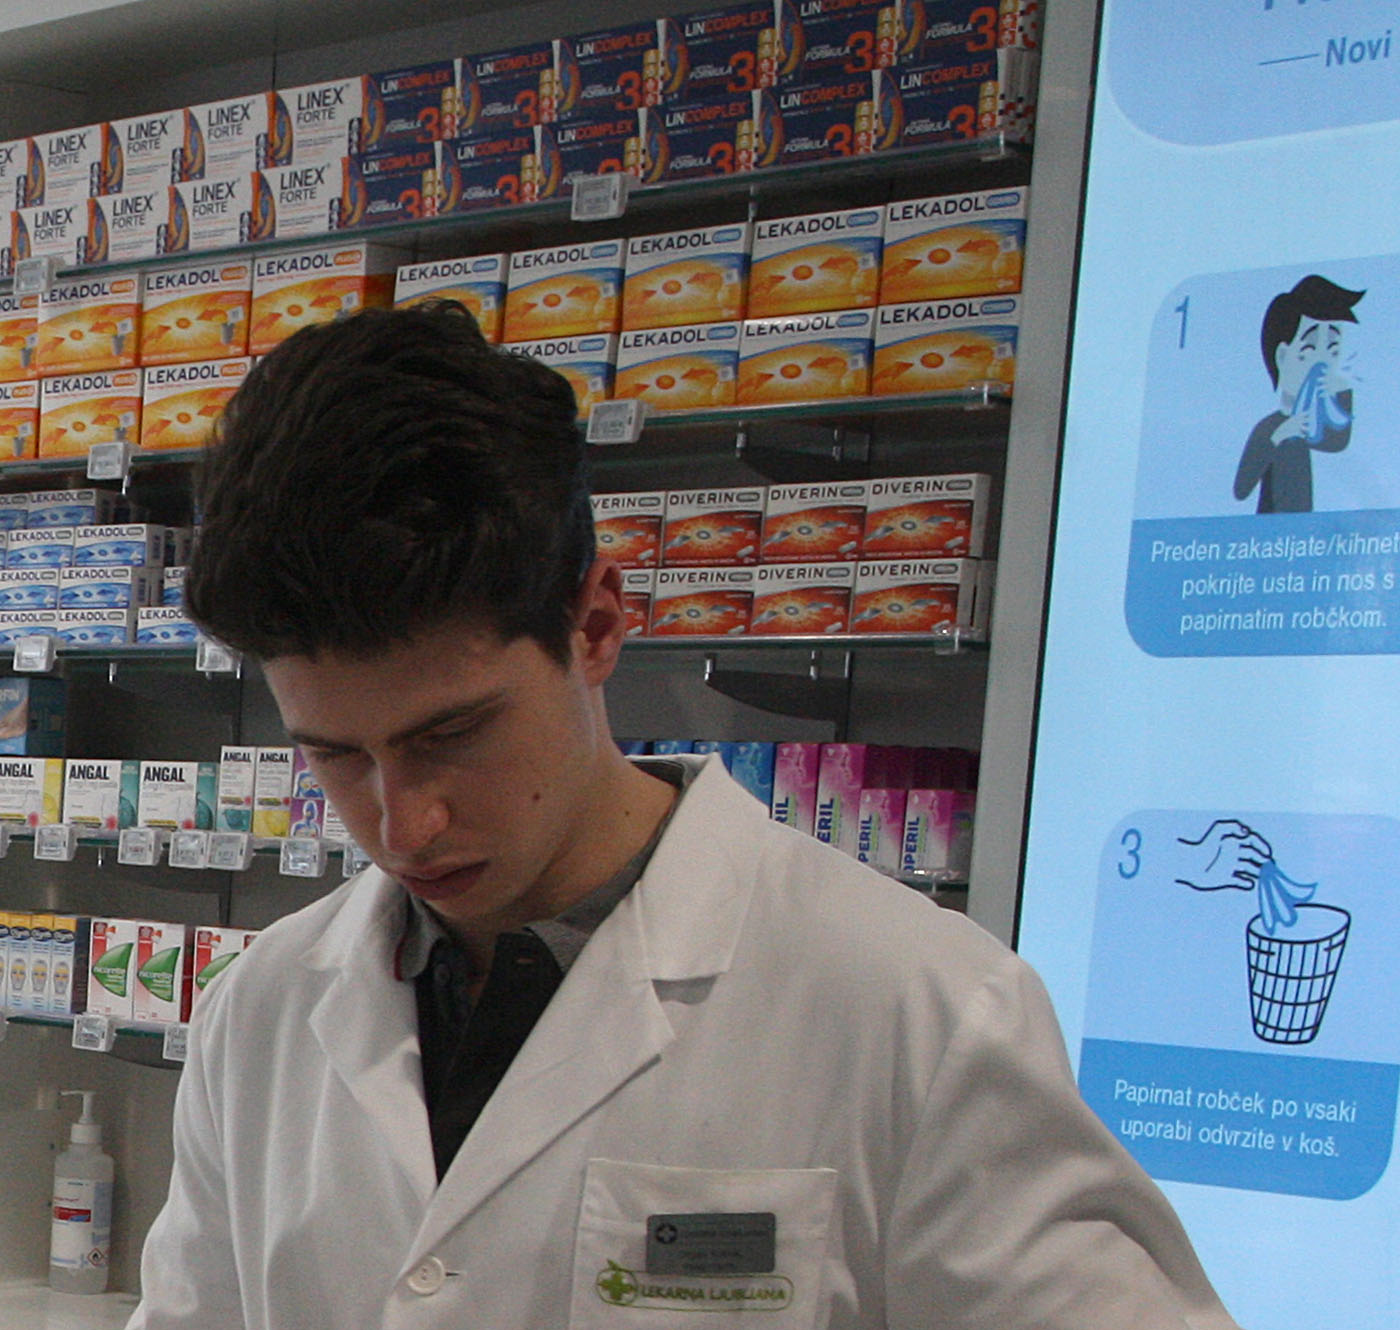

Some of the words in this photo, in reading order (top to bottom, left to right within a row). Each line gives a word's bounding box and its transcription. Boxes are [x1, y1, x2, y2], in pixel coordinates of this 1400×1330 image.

[684, 11, 770, 38] LINCOMPLEX
[967, 6, 998, 52] 3
[1325, 29, 1392, 67] Novi
[900, 61, 992, 90] LINCOMPLEX
[297, 86, 345, 111] LINEX
[207, 102, 252, 127] LINEX
[296, 106, 337, 126] FORTE
[126, 118, 170, 141] LINEX
[207, 122, 243, 140] FORTE
[126, 136, 161, 155] FORTE
[279, 166, 326, 190] LINEX
[192, 181, 237, 204] LINEX
[279, 185, 317, 204] FORTE
[112, 195, 154, 217] LINEX
[191, 200, 228, 218] FORTE
[889, 198, 985, 223] LEKADOL
[112, 212, 146, 229] FORTE
[756, 216, 846, 240] LEKADOL
[256, 254, 334, 277] LEKADOL
[512, 249, 591, 270] LEKADOL
[145, 270, 220, 291] LEKADOL
[1173, 294, 1190, 350] 1
[44, 376, 112, 395] LEKADOL
[770, 485, 838, 501] DIVERIN
[871, 478, 945, 496] DIVERIN
[9, 530, 56, 542] LEKADOL
[77, 526, 128, 538] LEKADOL
[1152, 540, 1220, 563] Preden
[61, 568, 113, 580] LEKADOL
[859, 562, 933, 577] DIVERIN
[1181, 573, 1255, 599] pokrijte
[1262, 574, 1304, 593] usta
[1311, 570, 1330, 591] in
[1336, 573, 1375, 592] nos
[1382, 572, 1395, 589] s
[1180, 607, 1284, 635] papirnatim
[1291, 605, 1388, 629] robčkom.
[143, 765, 186, 782] ANGAL
[1116, 827, 1143, 880] 3
[1114, 1078, 1192, 1108] Papirnat
[1197, 1088, 1265, 1114] robček
[1271, 1098, 1298, 1119] po
[1304, 1100, 1358, 1123] vsaki
[1120, 1117, 1192, 1142] uporabi
[1198, 1123, 1276, 1149] odvrzite
[1281, 1136, 1294, 1151] v
[1300, 1131, 1340, 1157] koš.
[641, 1284, 705, 1301] LEKARNA
[709, 1286, 785, 1301] LJUBLJANA
